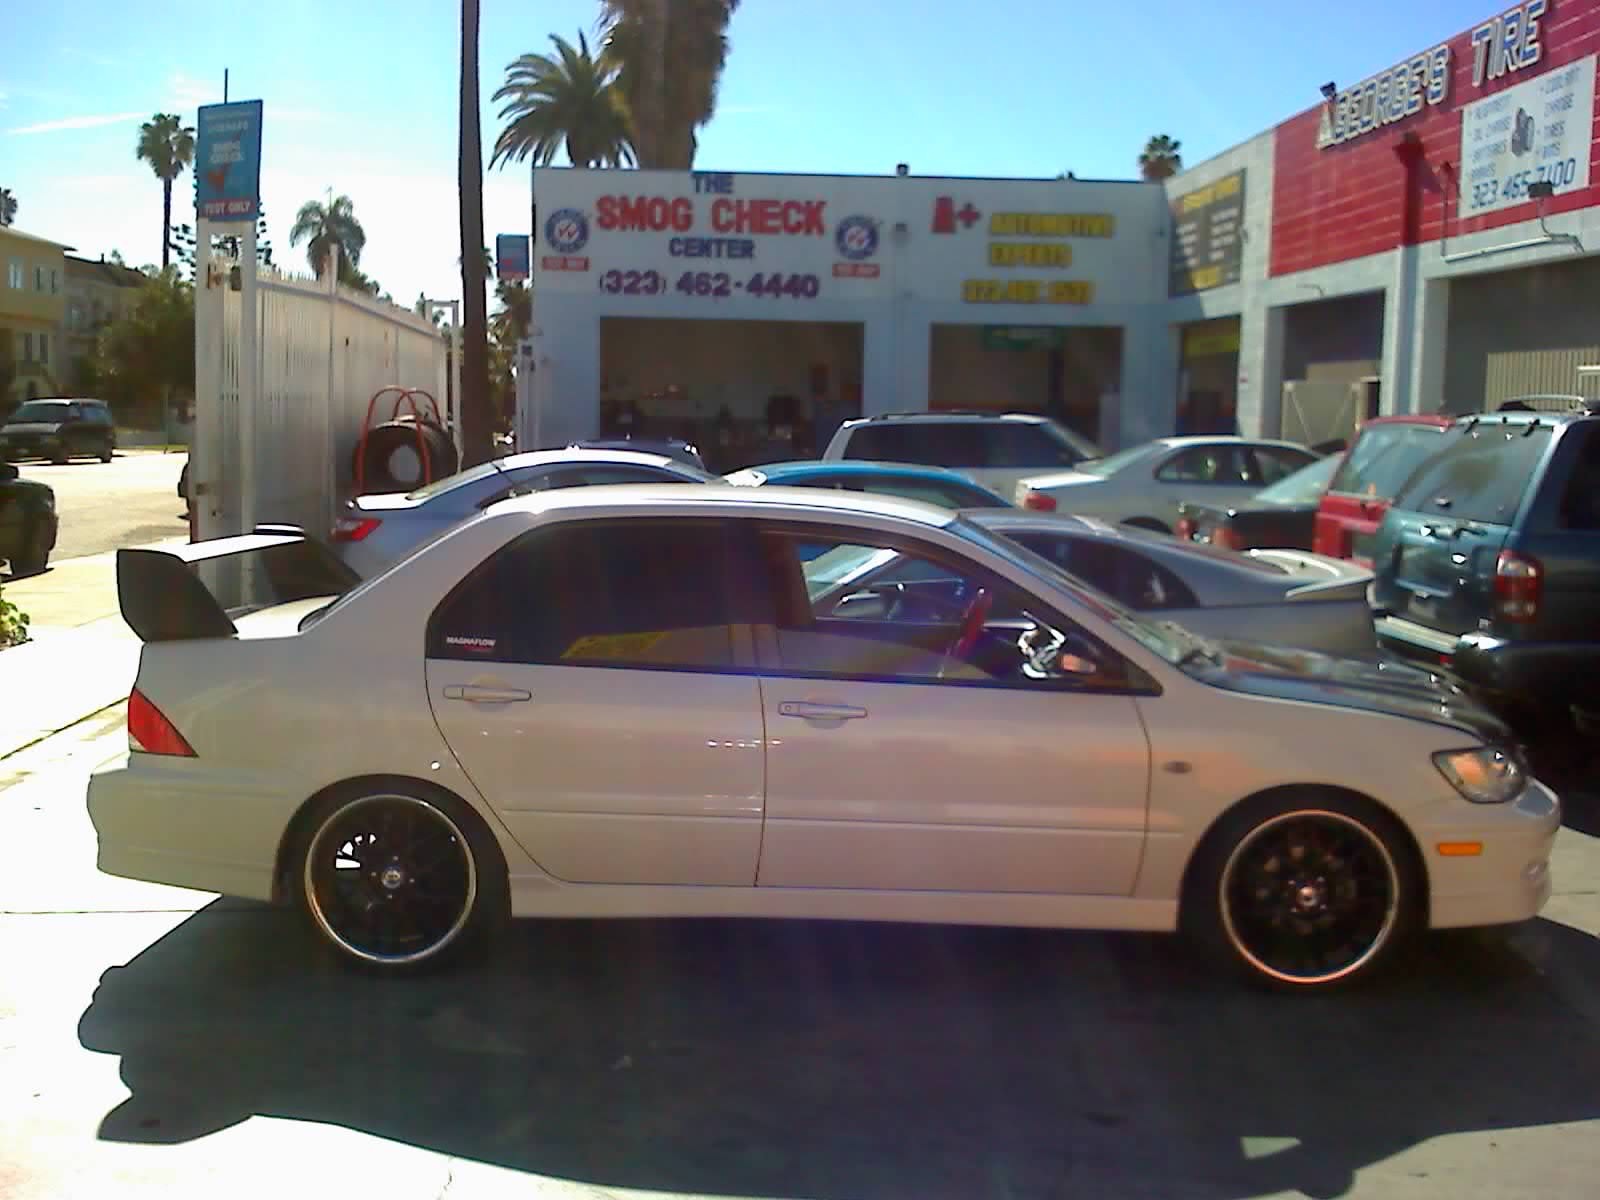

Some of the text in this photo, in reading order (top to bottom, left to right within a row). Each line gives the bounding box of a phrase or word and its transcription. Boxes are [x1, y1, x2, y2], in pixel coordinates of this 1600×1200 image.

[1471, 0, 1547, 87] TIRE
[692, 174, 735, 194] THE
[596, 195, 693, 232] SMOG
[712, 197, 827, 235] CHECK
[669, 237, 756, 259] CENTER
[600, 269, 667, 296] (323)
[677, 271, 820, 299] 462-4440
[446, 637, 496, 646] MAGNAFLOW
